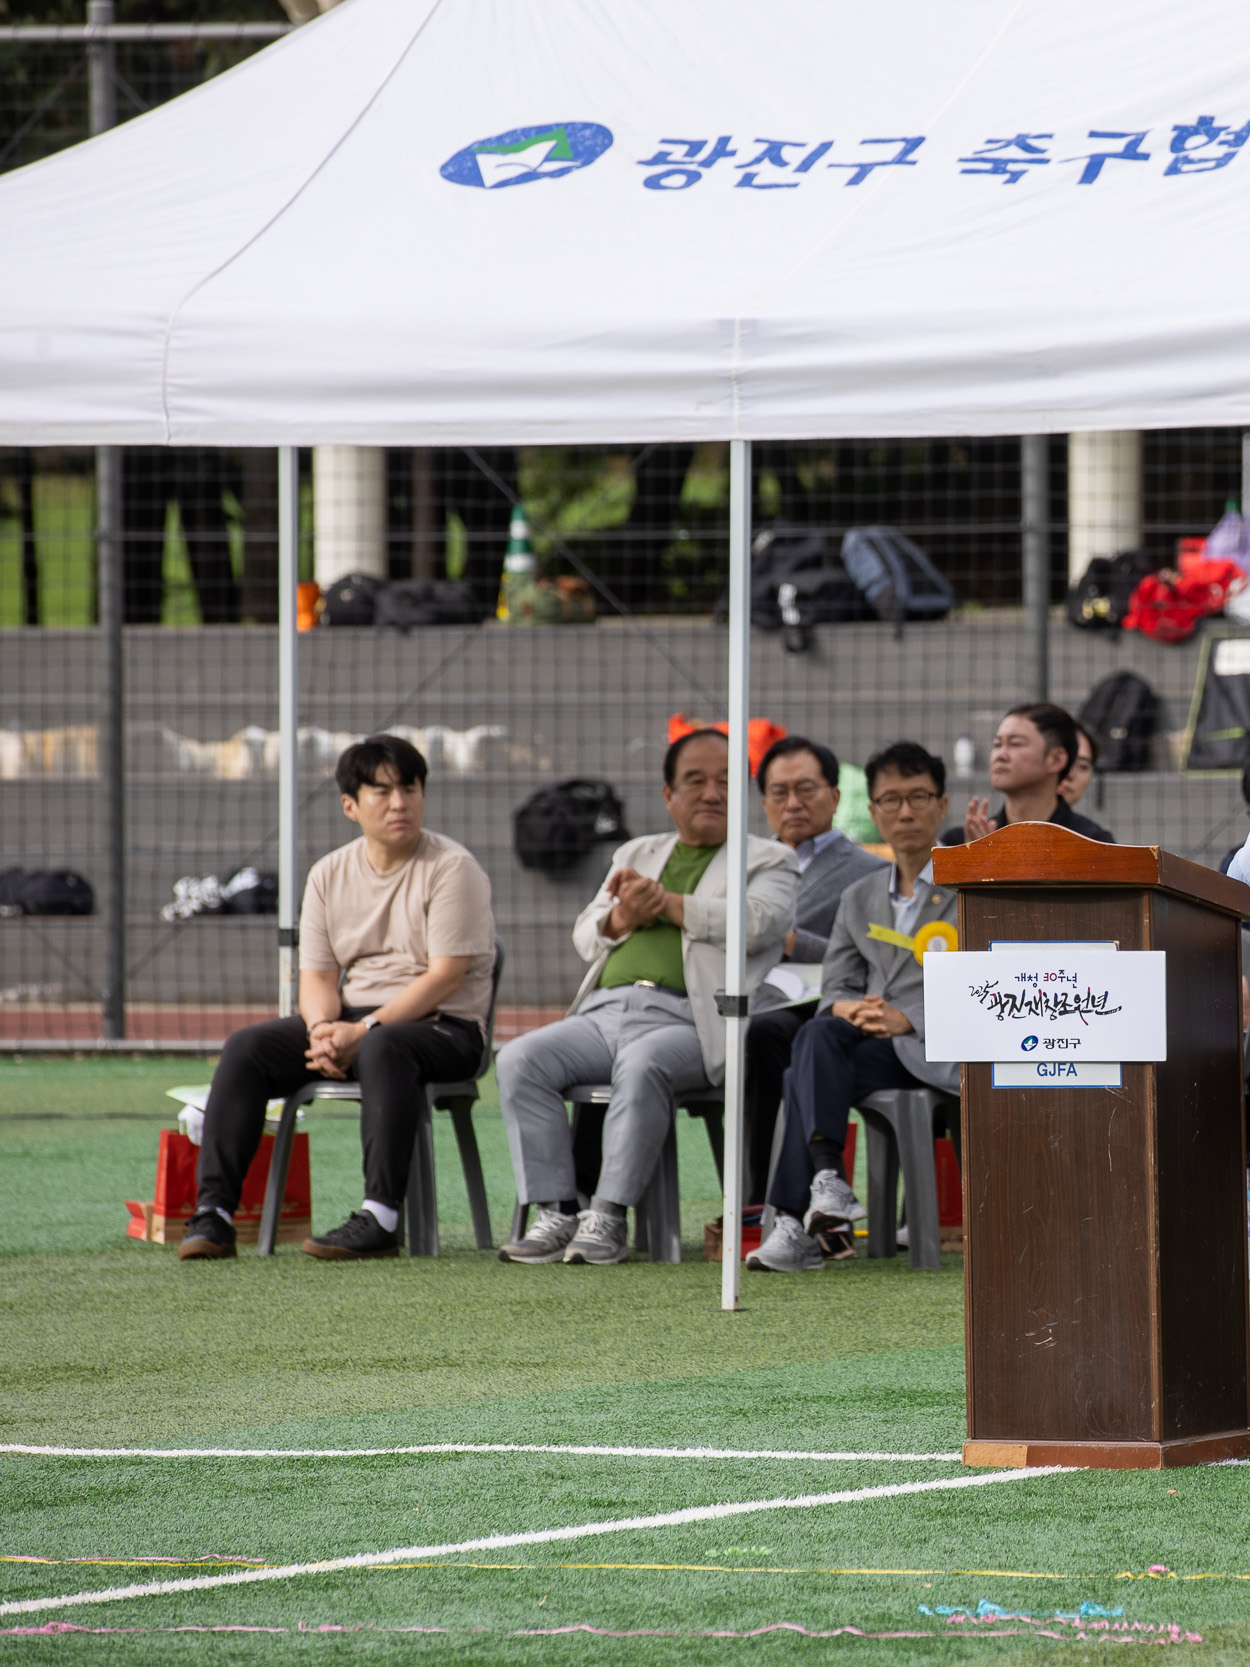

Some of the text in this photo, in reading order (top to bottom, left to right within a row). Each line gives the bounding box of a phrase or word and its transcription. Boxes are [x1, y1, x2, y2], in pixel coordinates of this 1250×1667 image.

[637, 135, 926, 192] 광진구
[1014, 970, 1078, 989] 개청 30주년
[1042, 1038, 1082, 1050] 광진구
[1036, 1063, 1078, 1077] GJFA
